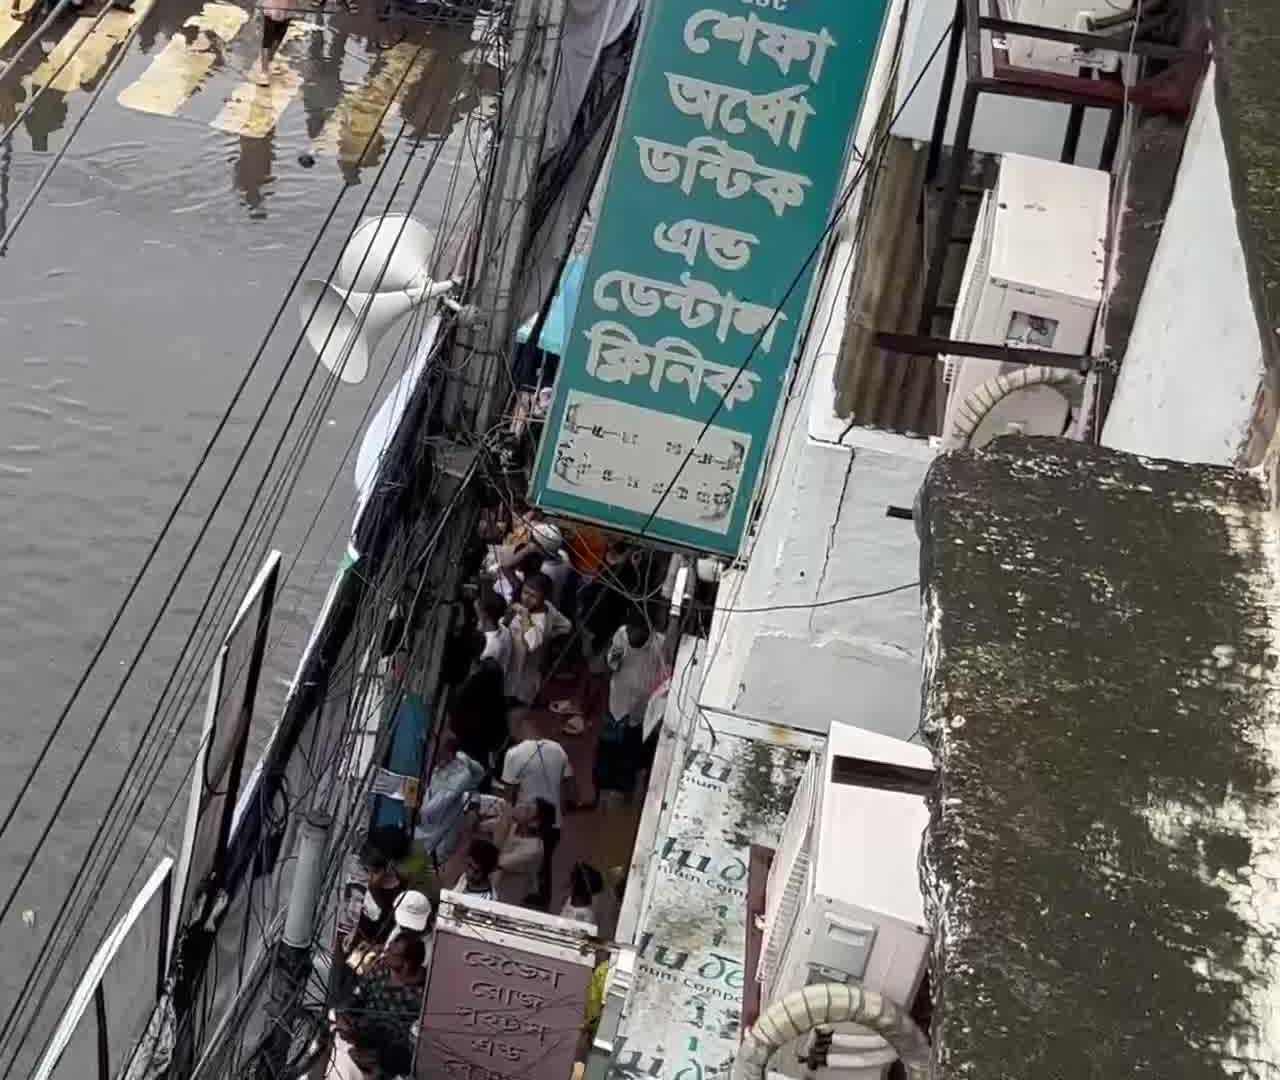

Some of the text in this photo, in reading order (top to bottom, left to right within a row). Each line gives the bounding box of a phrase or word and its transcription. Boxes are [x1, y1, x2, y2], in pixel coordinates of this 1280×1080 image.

[683, 8, 838, 84] শেফা
[593, 270, 790, 354] ডেন্টাল
[582, 320, 763, 412] ক্লিনিক
